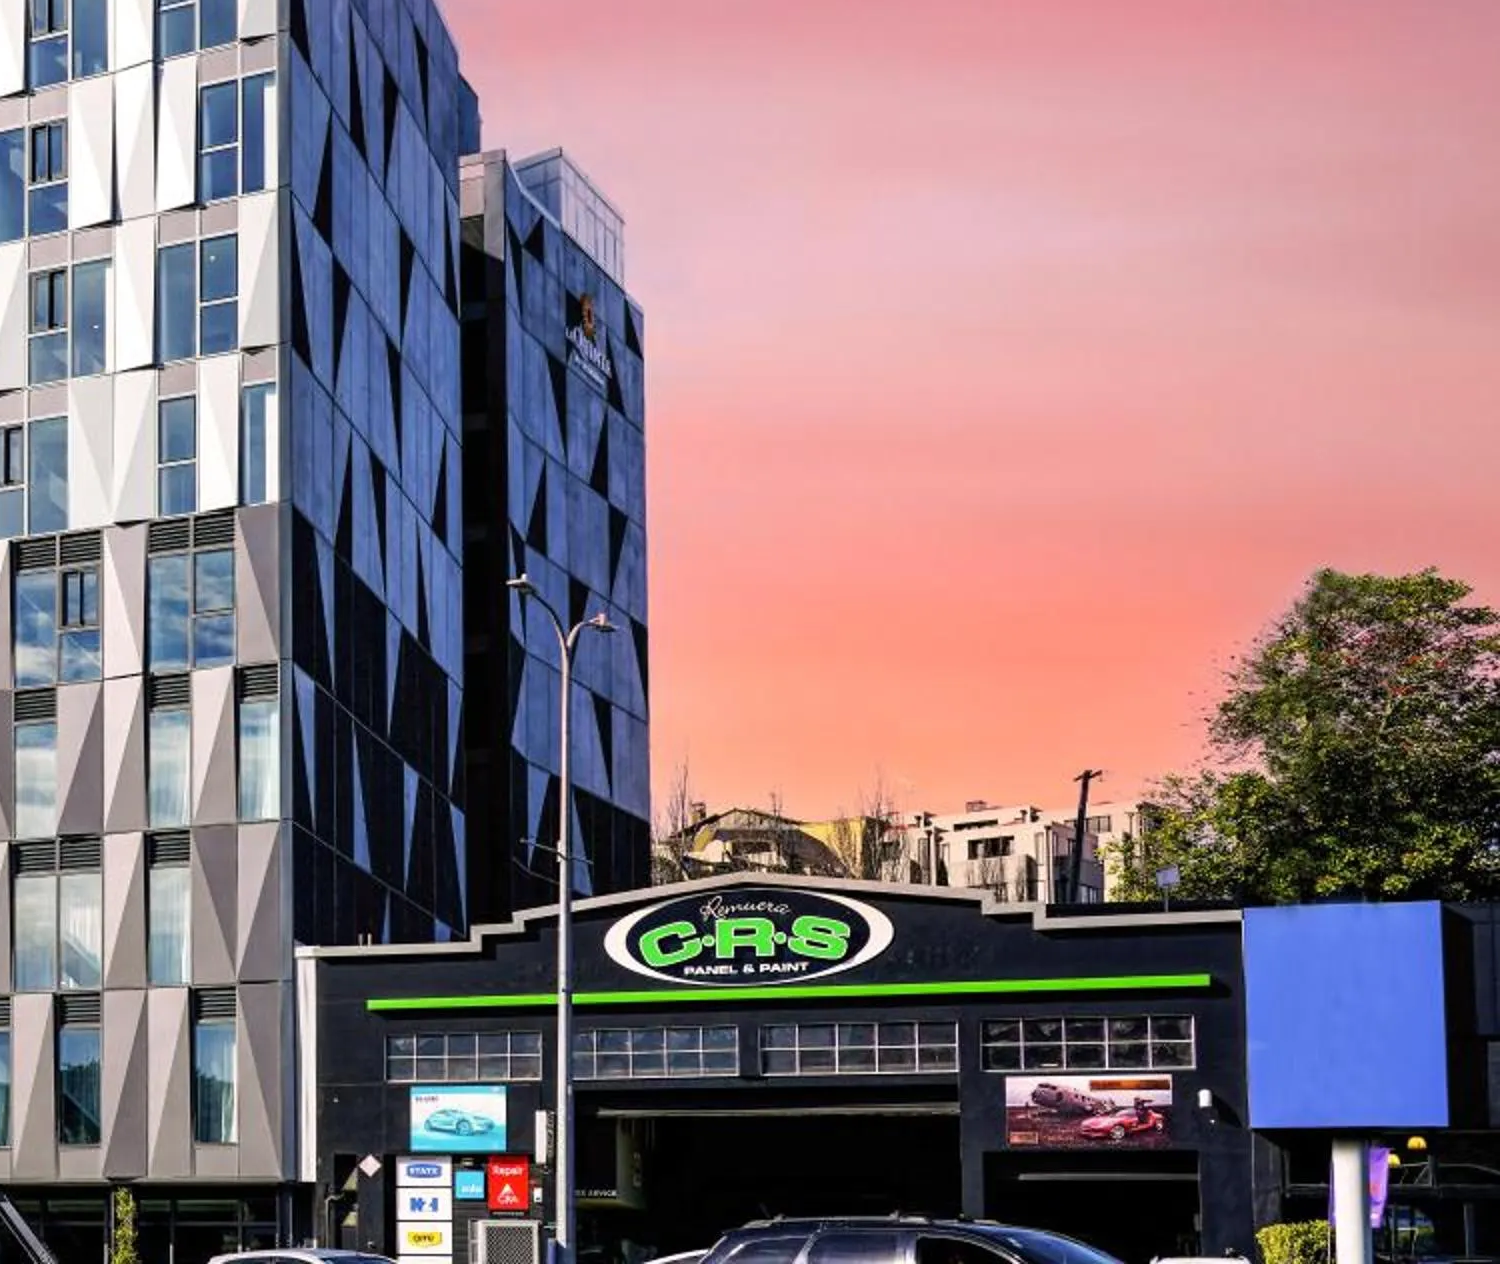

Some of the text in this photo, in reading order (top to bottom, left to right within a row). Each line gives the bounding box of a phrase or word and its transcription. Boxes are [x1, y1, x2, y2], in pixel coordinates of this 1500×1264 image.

[700, 895, 792, 920] Remuera
[683, 961, 810, 976] PANEL & PAINT
[492, 1165, 522, 1176] Repair
